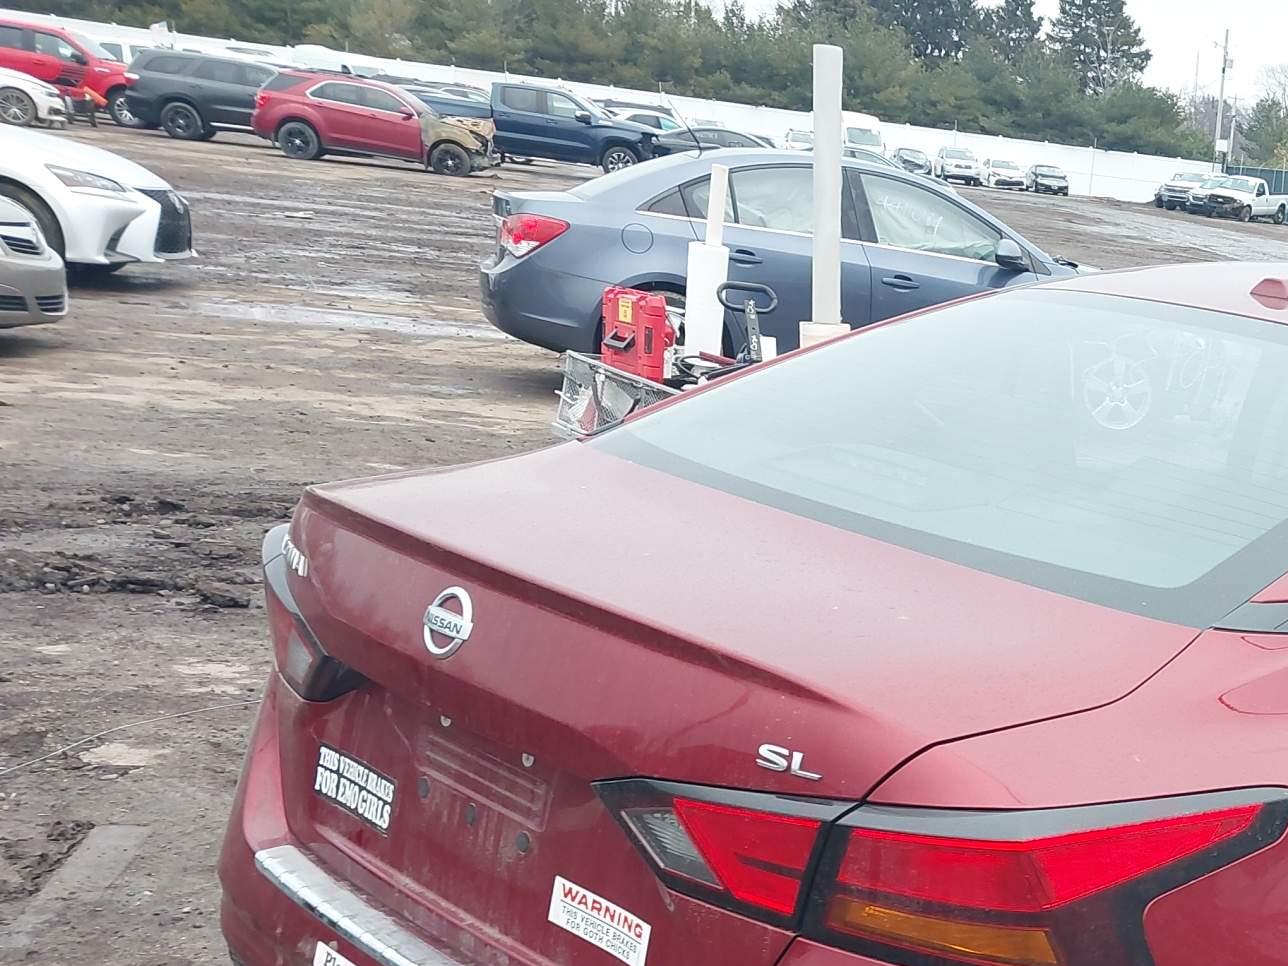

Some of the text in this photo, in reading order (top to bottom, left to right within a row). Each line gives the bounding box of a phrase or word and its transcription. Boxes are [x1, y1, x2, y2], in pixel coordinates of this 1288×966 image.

[319, 746, 339, 770] THIS
[339, 755, 369, 788] VEHICLE
[755, 743, 823, 781] SL
[314, 766, 392, 829] FOR EMO GIRLS
[561, 905, 637, 954] THIS VEHICLE BRAKES
[562, 883, 644, 940] WARNING
[565, 918, 630, 960] FOR GOTH CHICKS
